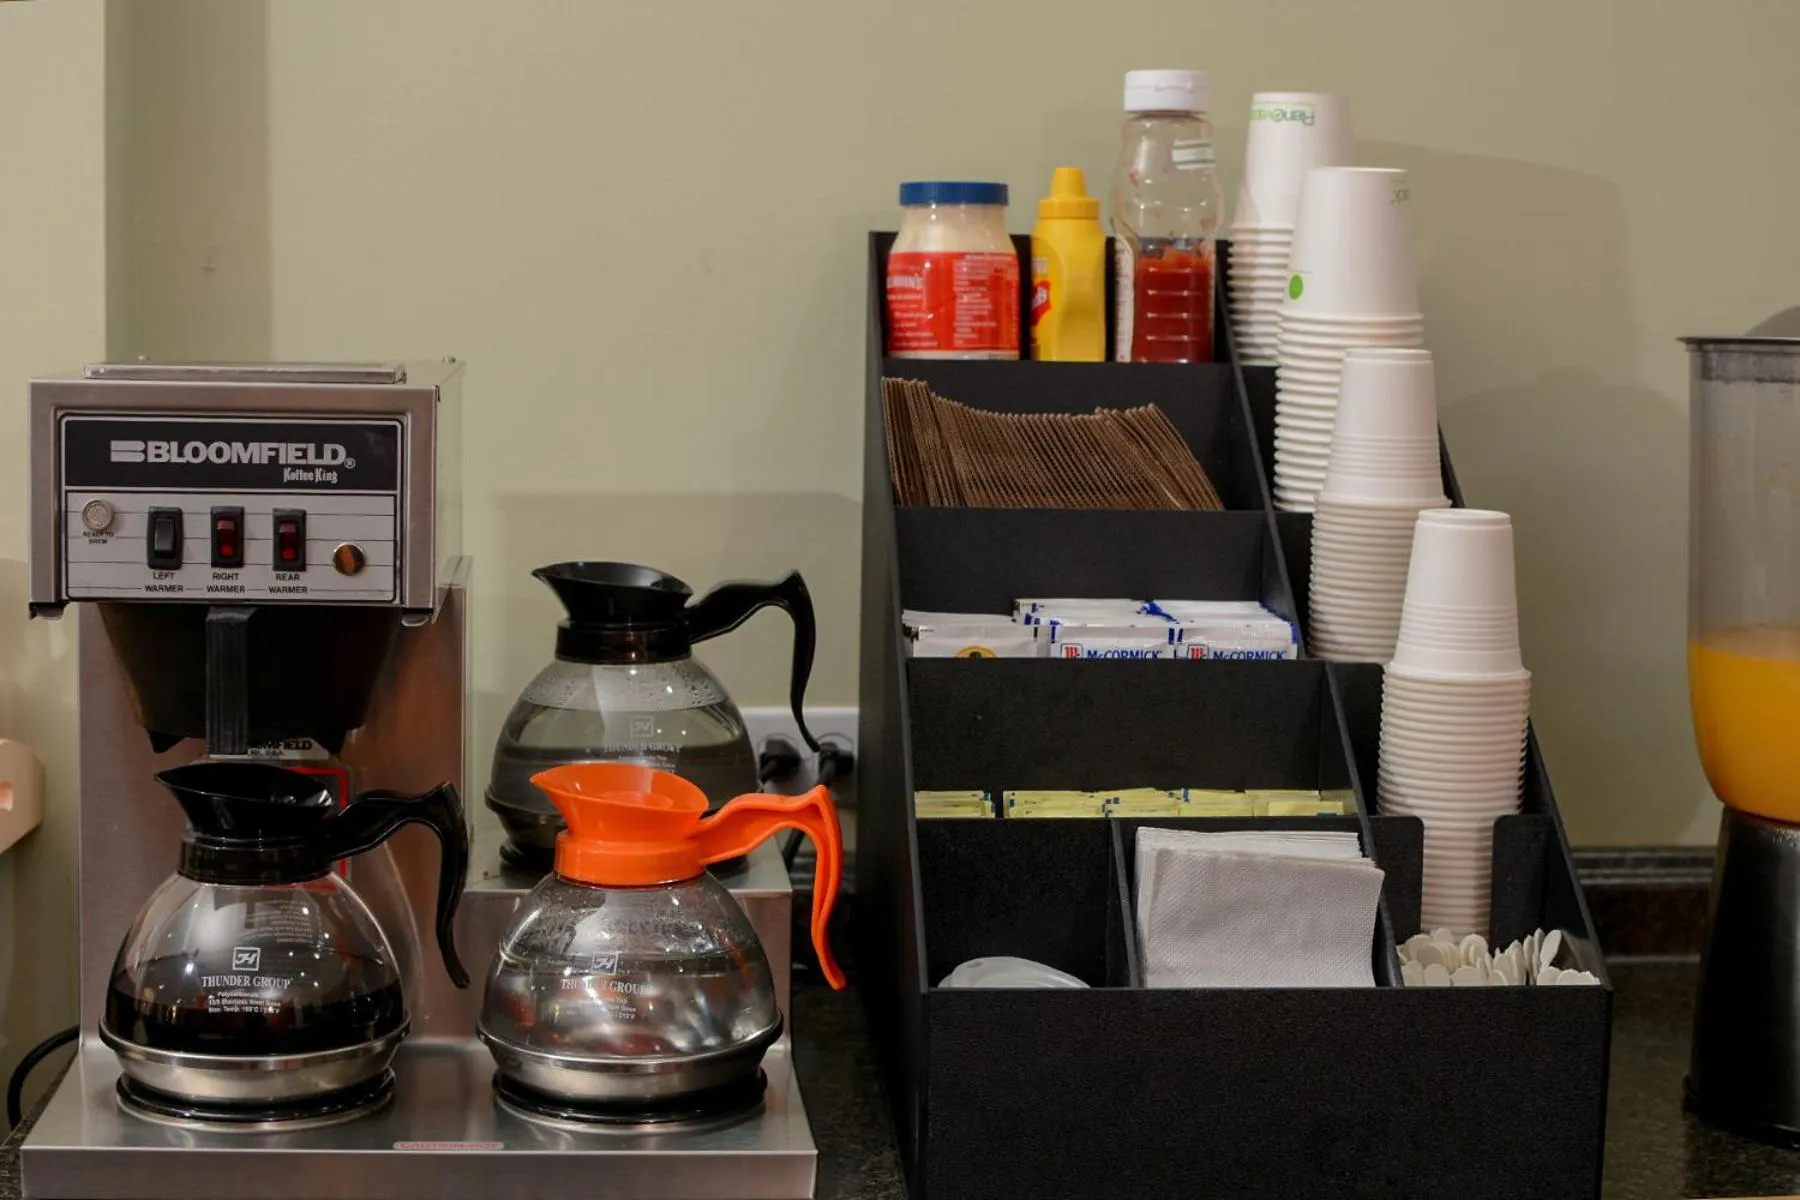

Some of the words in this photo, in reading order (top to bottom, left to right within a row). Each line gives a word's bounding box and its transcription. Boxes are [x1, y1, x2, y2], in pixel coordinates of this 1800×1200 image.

[147, 441, 347, 465] BLOOMFIELD
[314, 468, 338, 484] King
[153, 572, 175, 580] LEFT
[212, 572, 239, 580] RIGHT
[275, 573, 300, 581] REAR
[207, 585, 246, 593] WARMER
[269, 586, 308, 594] WARMER
[201, 975, 251, 988] THUNDER
[253, 976, 291, 989] GROUP
